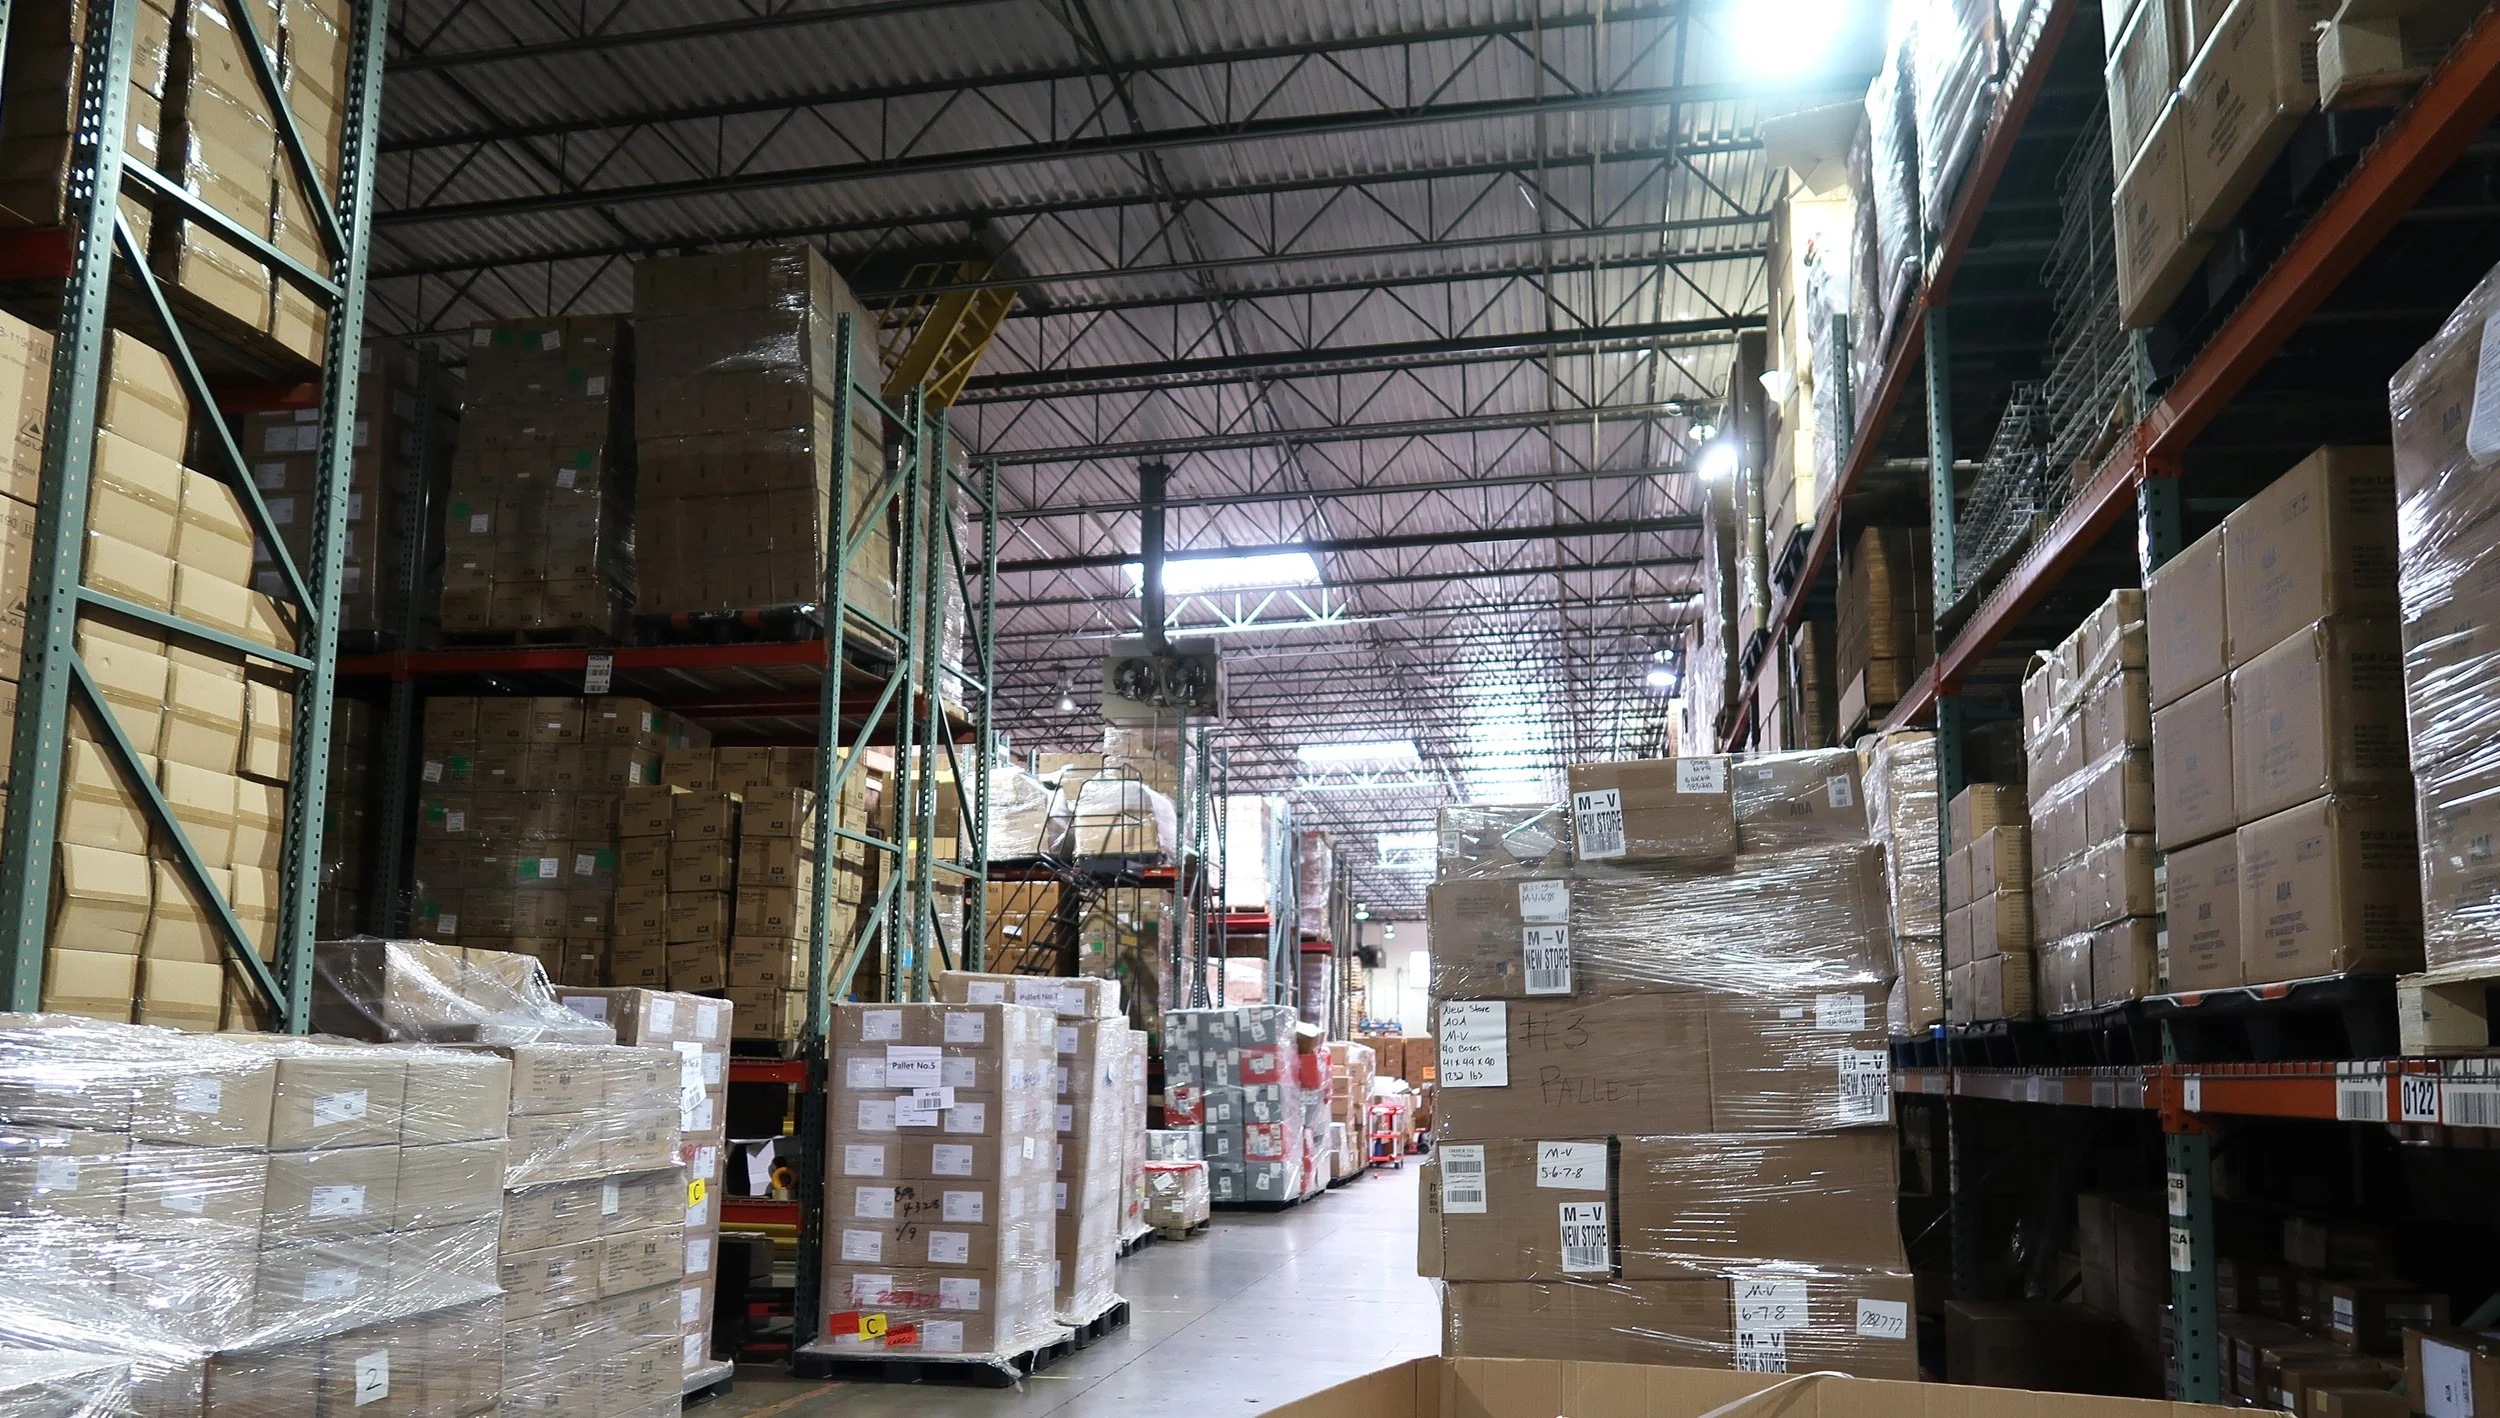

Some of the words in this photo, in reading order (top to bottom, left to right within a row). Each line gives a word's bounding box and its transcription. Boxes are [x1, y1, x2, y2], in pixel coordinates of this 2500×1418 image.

[1577, 813, 1595, 835] NEW
[1597, 811, 1622, 834] STORE
[1525, 949, 1543, 970] NEW
[1544, 948, 1569, 969] STORE
[1019, 993, 1040, 1001] Pallet
[1442, 1005, 1464, 1015] New
[1469, 1004, 1490, 1014] Store
[1444, 1017, 1467, 1027] AOA
[891, 1061, 914, 1070] Pallet
[916, 1062, 936, 1070] No.5
[1539, 1065, 1648, 1107] PALLET
[1840, 1073, 1859, 1096] NEW
[1861, 1073, 1887, 1096] STORE
[2403, 1080, 2434, 1115] 0122
[1545, 1147, 1573, 1159] M-V
[1541, 1166, 1585, 1179] 5-6-7-8
[693, 1184, 701, 1201] C
[1561, 1226, 1580, 1247] NEW
[1581, 1225, 1607, 1247] STORE
[1745, 1285, 1776, 1299] M-V
[1742, 1305, 1786, 1321] 6-7-8
[866, 1318, 879, 1335] C
[1738, 1353, 1757, 1373] NEW
[1758, 1352, 1786, 1374] STORE
[364, 1367, 382, 1392] 2
